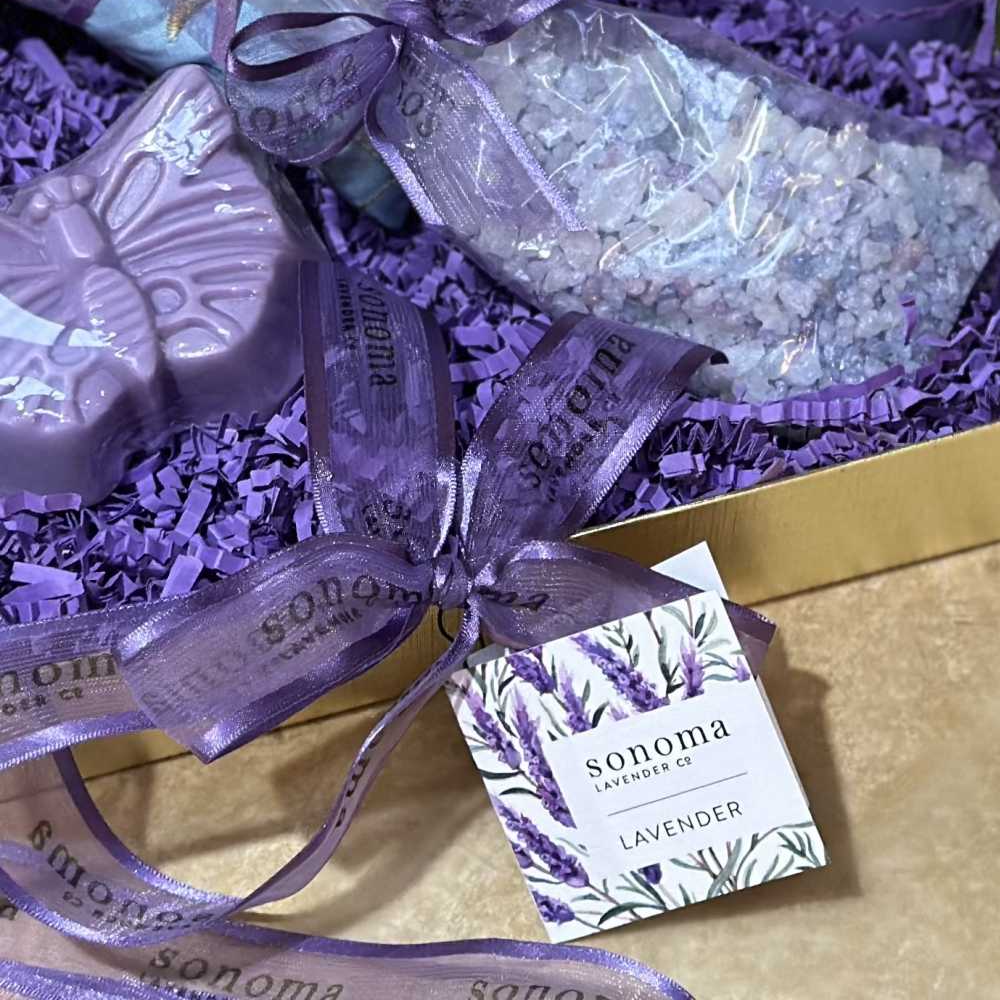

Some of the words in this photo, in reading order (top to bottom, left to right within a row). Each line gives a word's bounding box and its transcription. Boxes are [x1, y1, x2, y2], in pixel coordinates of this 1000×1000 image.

[586, 719, 731, 778] sonoma
[594, 762, 670, 793] LAVENDER
[619, 800, 743, 851] LAVENDER
[148, 947, 344, 1000] sonoma
